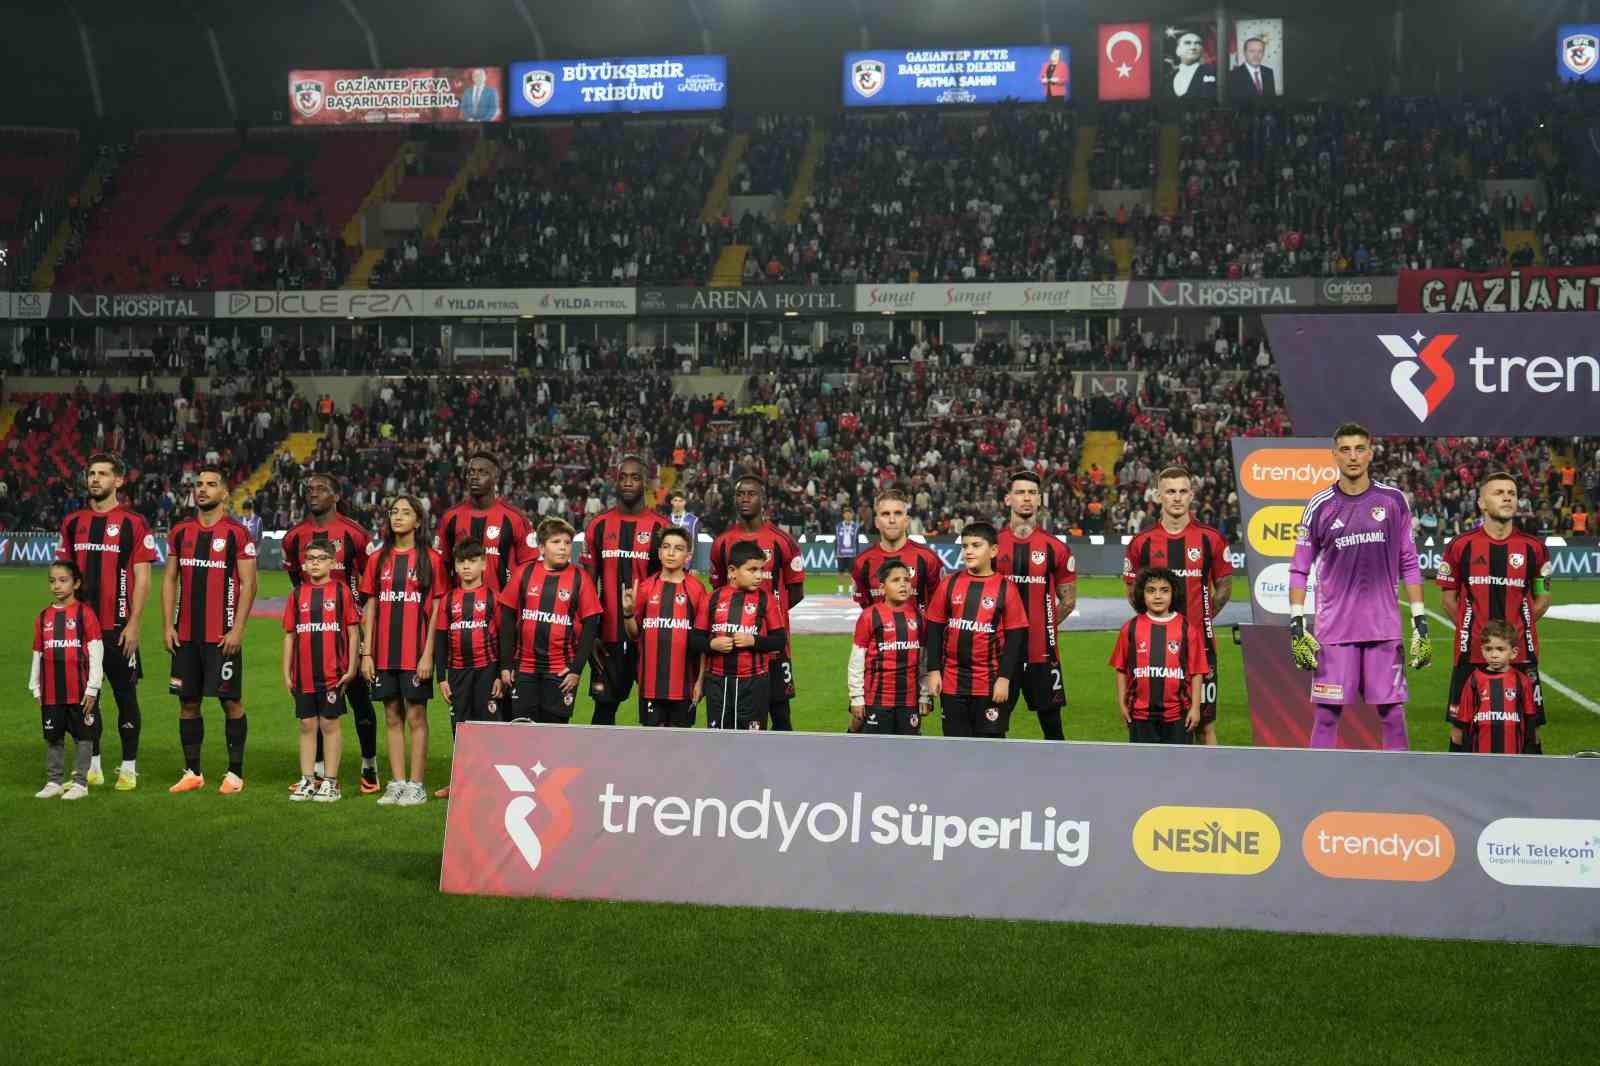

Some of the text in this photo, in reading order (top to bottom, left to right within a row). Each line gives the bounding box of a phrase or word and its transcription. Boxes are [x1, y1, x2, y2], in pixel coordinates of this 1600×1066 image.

[562, 60, 683, 82] BÜYÜKŞEHİR
[582, 82, 664, 102] TRİBÜNÜ
[692, 290, 841, 309] ARENA HOTEL
[1200, 287, 1297, 305] HOSPITAL
[113, 299, 199, 317] HOSPITAL
[1469, 347, 1600, 393] tren
[1335, 531, 1386, 549] ŞEHİTKAMİL
[1469, 576, 1526, 587] ŞEHİTKAMİL
[221, 661, 233, 681] 6
[781, 662, 792, 684] 3
[1051, 668, 1062, 690] 2
[599, 783, 862, 853] trendyol
[1317, 830, 1441, 862] trendyol
[1486, 842, 1594, 859] Türk Telekom
